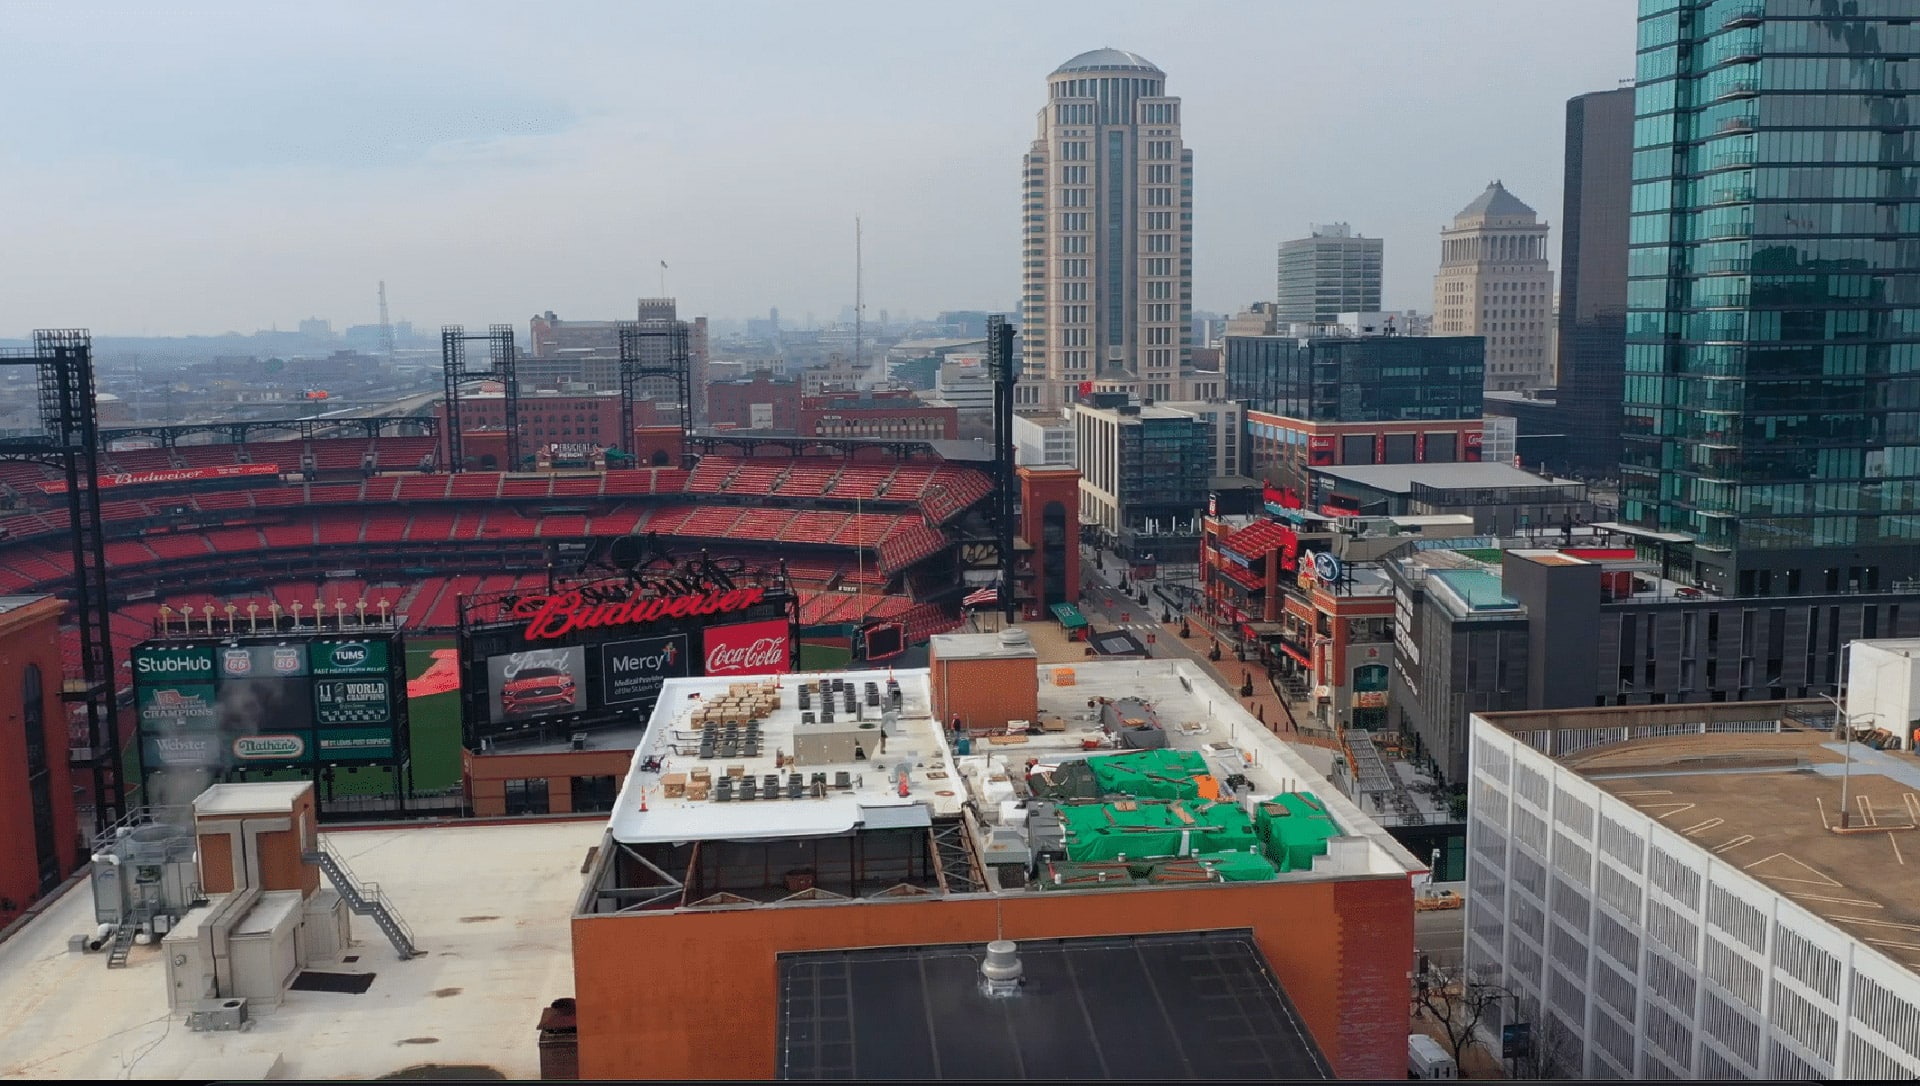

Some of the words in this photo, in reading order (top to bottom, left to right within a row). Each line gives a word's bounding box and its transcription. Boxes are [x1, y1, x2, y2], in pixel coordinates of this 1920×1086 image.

[114, 469, 203, 485] Budweiser
[513, 587, 764, 640] Budweiser
[335, 651, 364, 660] TUMS
[705, 636, 786, 673] Coca-Cola
[138, 655, 212, 672] StubHub
[612, 655, 664, 674] Mercy
[318, 684, 331, 697] 11
[346, 683, 385, 694] WORLD
[346, 693, 385, 702] CHAMPIONS
[143, 708, 214, 719] CHAMPIONS
[155, 738, 206, 751] Webster
[239, 738, 297, 752] Nathan's
